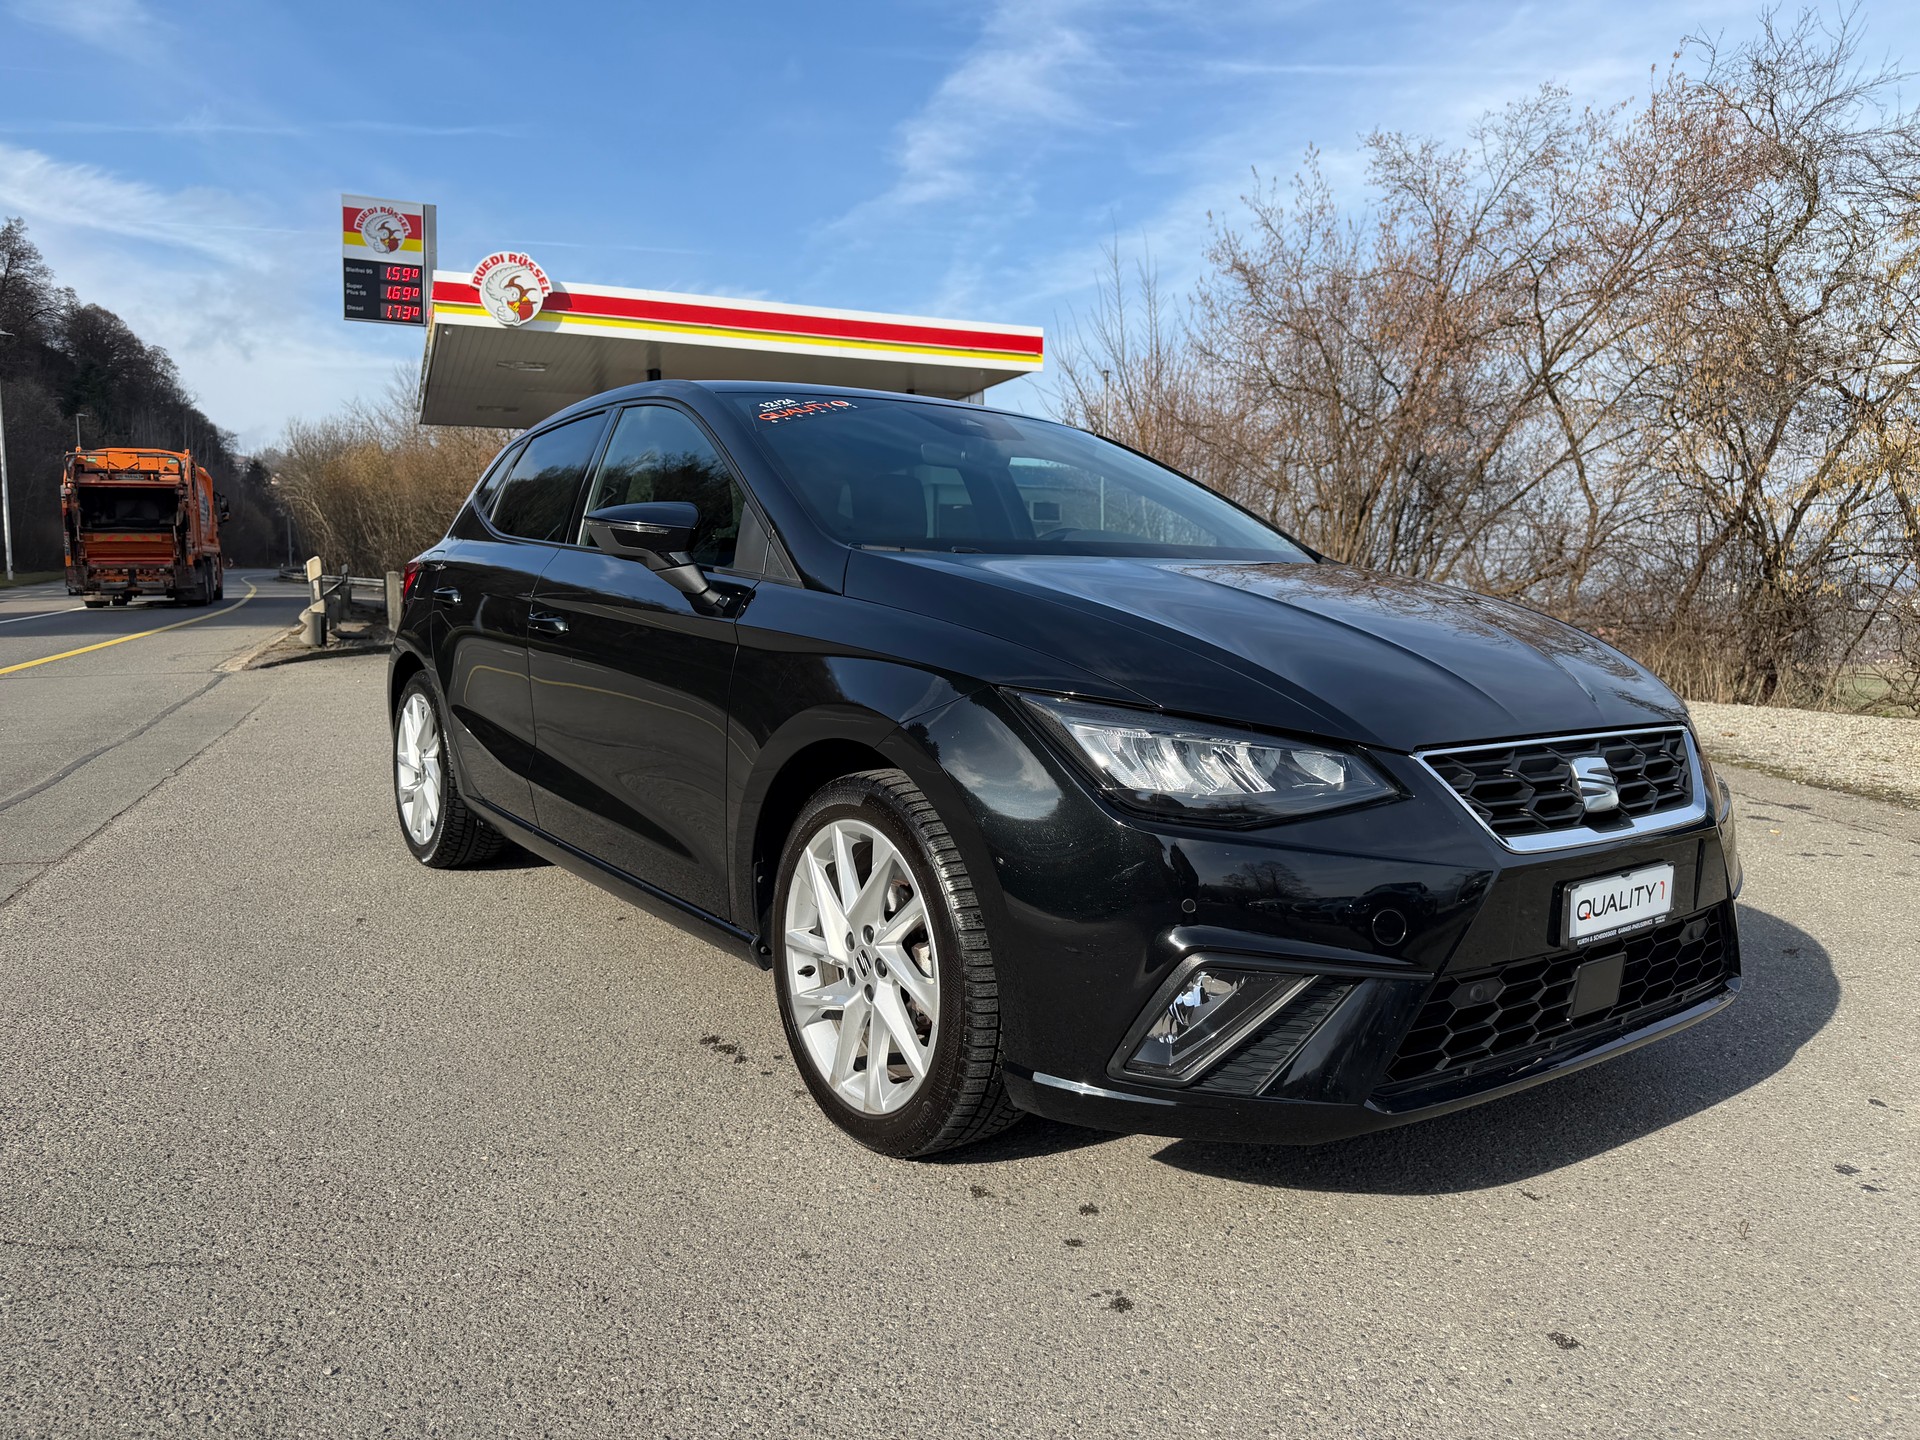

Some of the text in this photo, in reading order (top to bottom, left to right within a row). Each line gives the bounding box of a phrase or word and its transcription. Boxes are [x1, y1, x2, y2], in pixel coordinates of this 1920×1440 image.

[355, 205, 411, 234] RUEDI RÜSSEL
[472, 252, 552, 295] RUEDI RÜSSEL
[758, 402, 833, 421] QUALITY
[759, 398, 796, 409] 12/24
[1576, 880, 1666, 921] QUALITY 1
